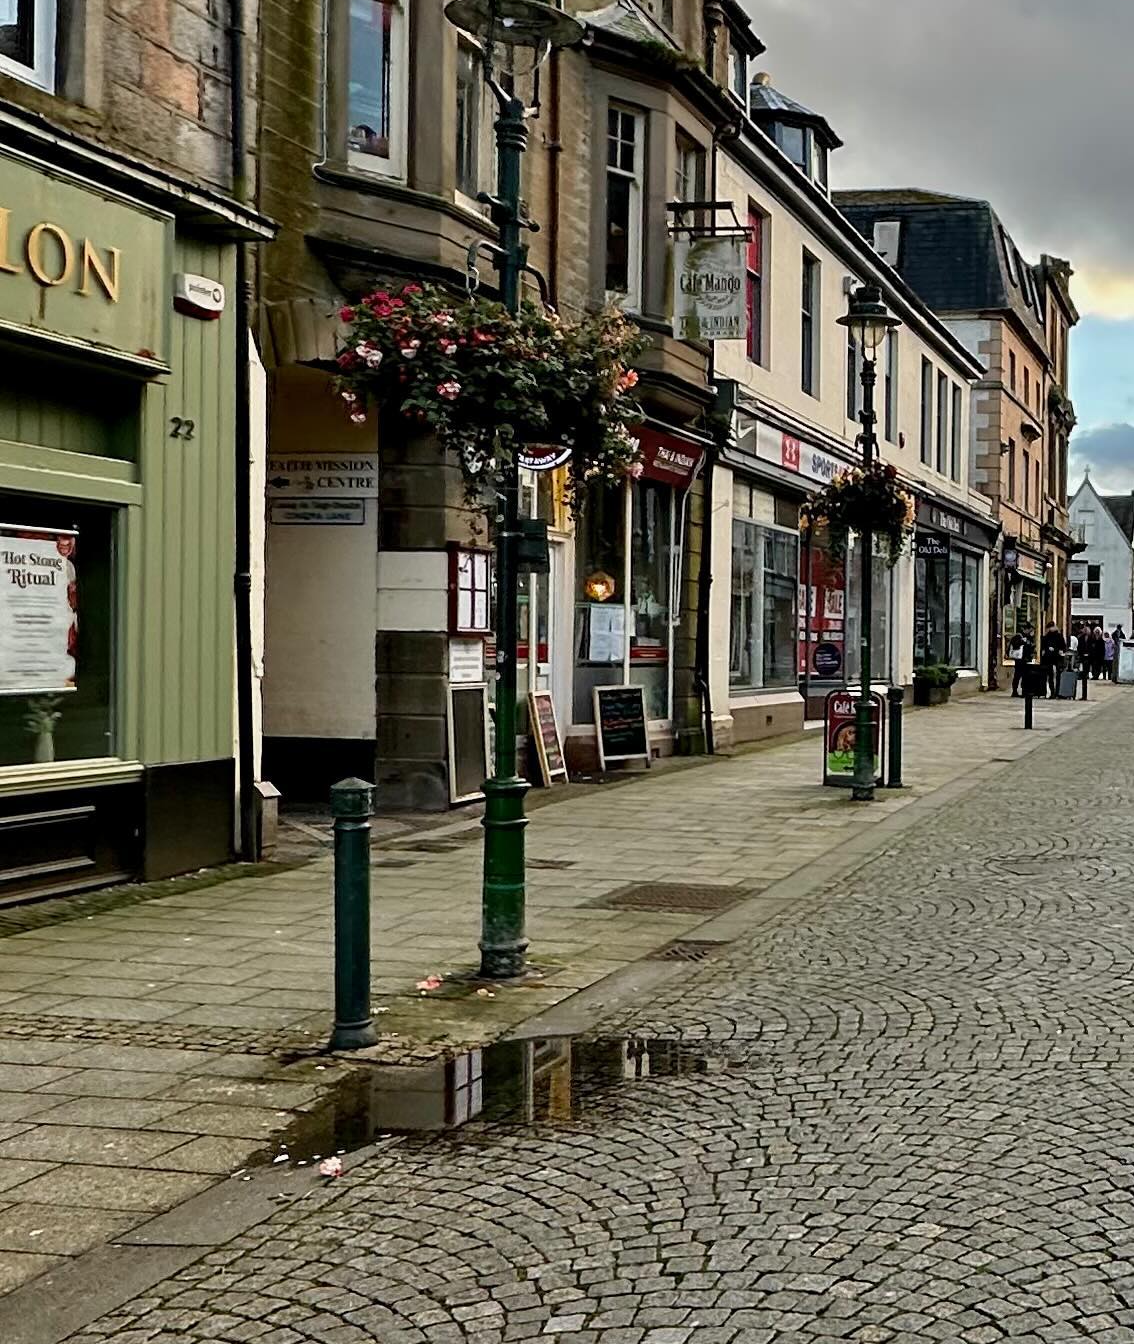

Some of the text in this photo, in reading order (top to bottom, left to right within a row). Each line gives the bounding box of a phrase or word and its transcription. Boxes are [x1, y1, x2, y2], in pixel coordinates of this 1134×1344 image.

[705, 272, 741, 294] Mango
[169, 417, 194, 441] 22
[316, 460, 375, 472] MISSION
[317, 477, 374, 489] CENTRE
[926, 537, 940, 546] The
[7, 568, 56, 589] Ritual
